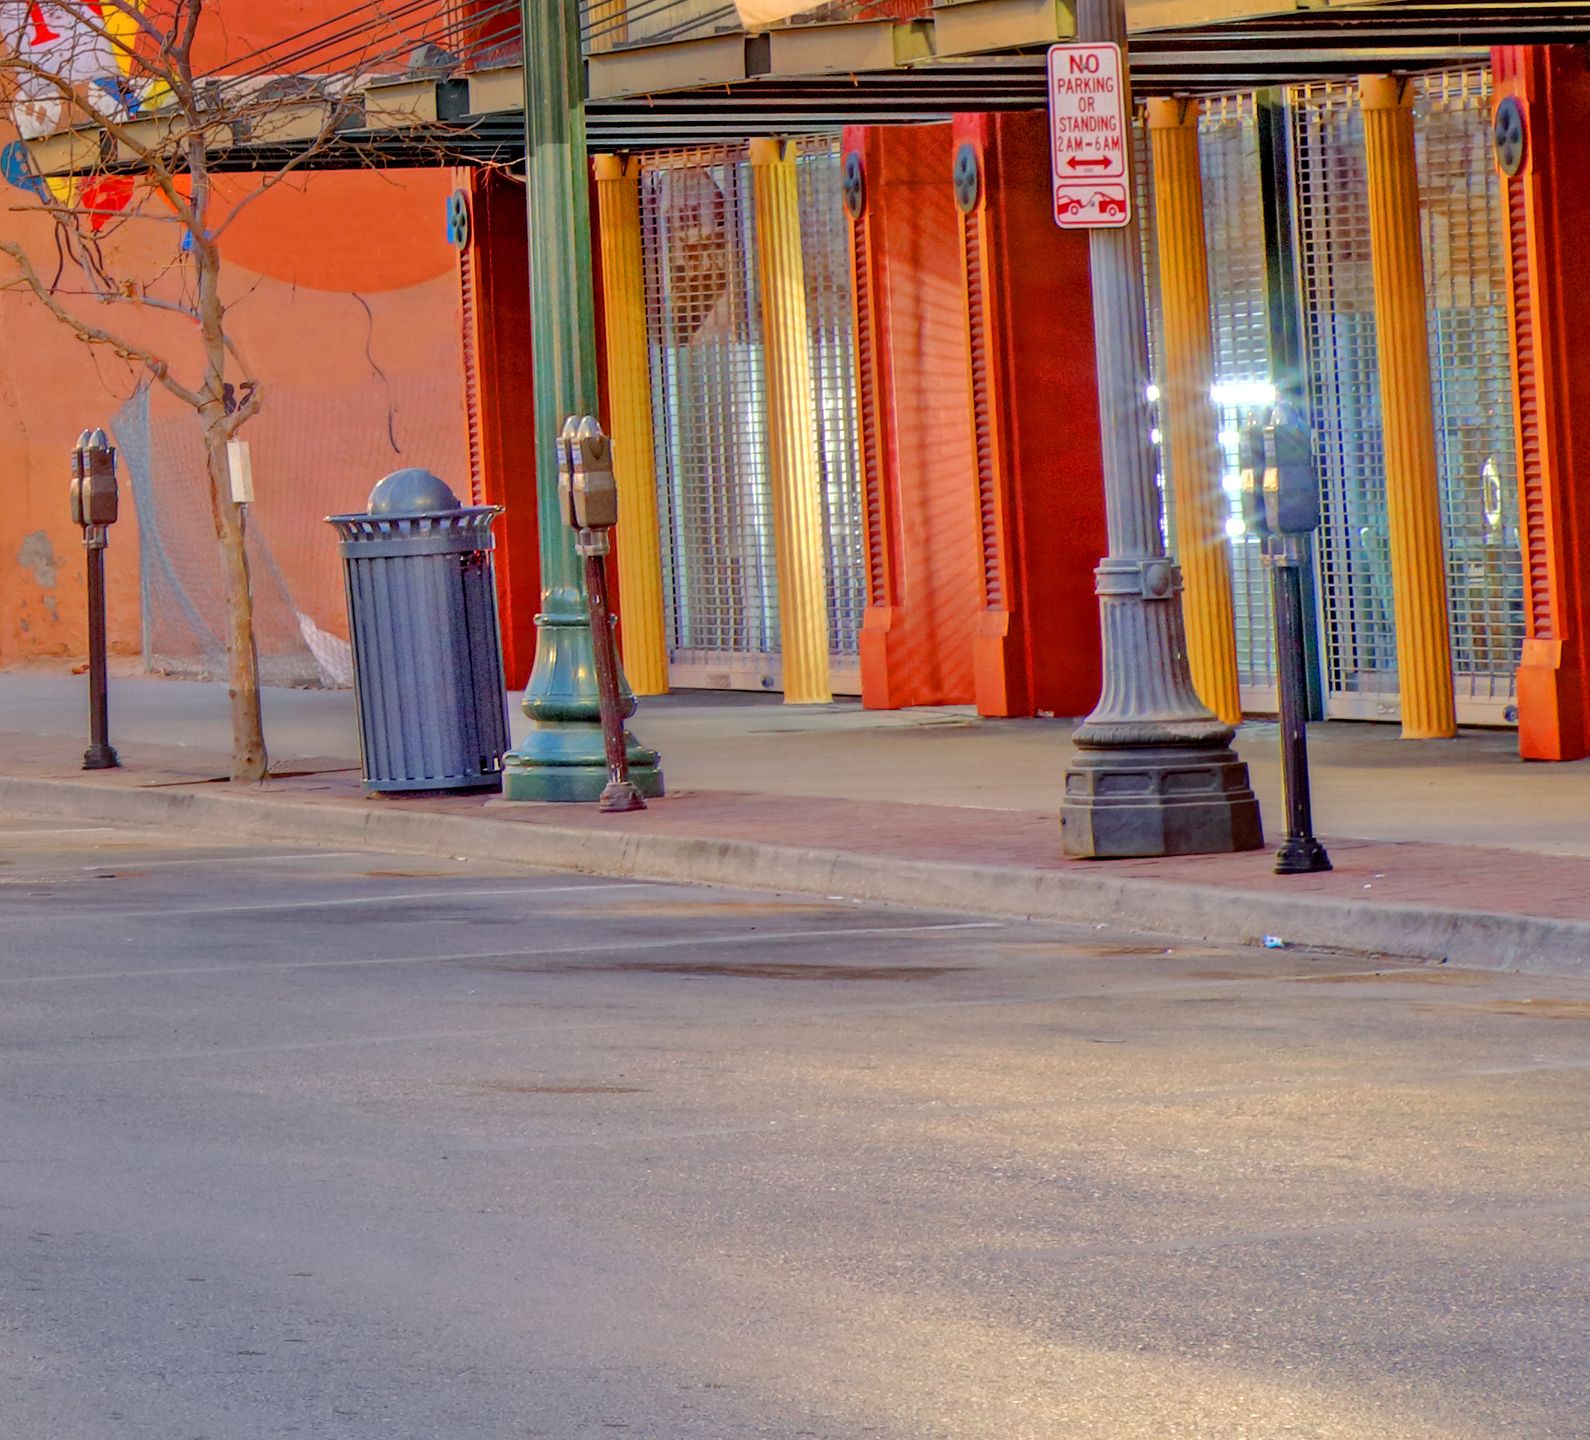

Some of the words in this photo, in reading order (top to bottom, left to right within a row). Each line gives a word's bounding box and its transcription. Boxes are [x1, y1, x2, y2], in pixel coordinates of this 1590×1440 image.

[1069, 53, 1100, 74] NO
[1057, 77, 1114, 94] PARKING
[1078, 96, 1095, 113] OR
[1059, 116, 1117, 132] STANDING
